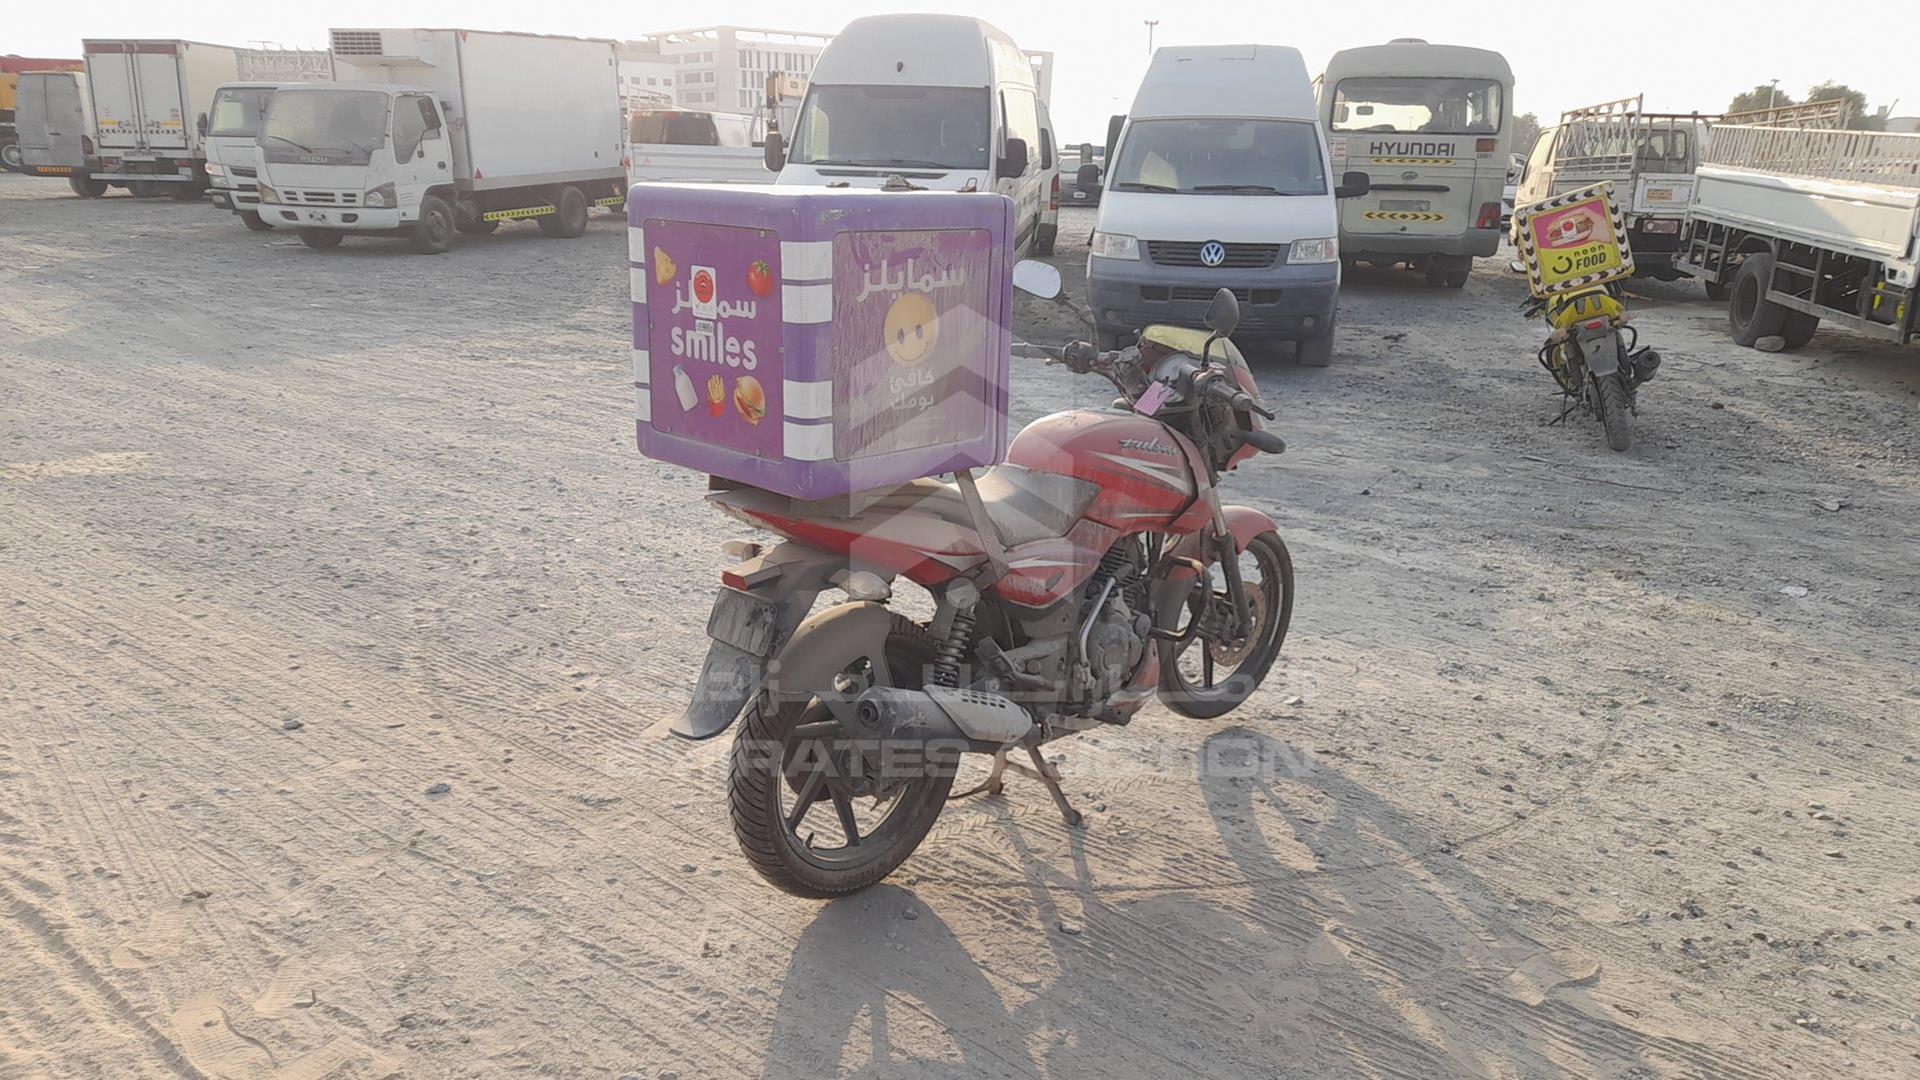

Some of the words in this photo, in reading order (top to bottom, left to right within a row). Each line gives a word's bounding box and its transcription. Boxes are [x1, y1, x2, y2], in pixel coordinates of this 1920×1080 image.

[1369, 141, 1456, 157] HYUNDAI
[1574, 244, 1606, 258] noon
[1576, 252, 1607, 270] FOOD
[855, 257, 966, 303] سمايلز
[671, 279, 757, 319] سملز
[670, 321, 758, 371] smiles
